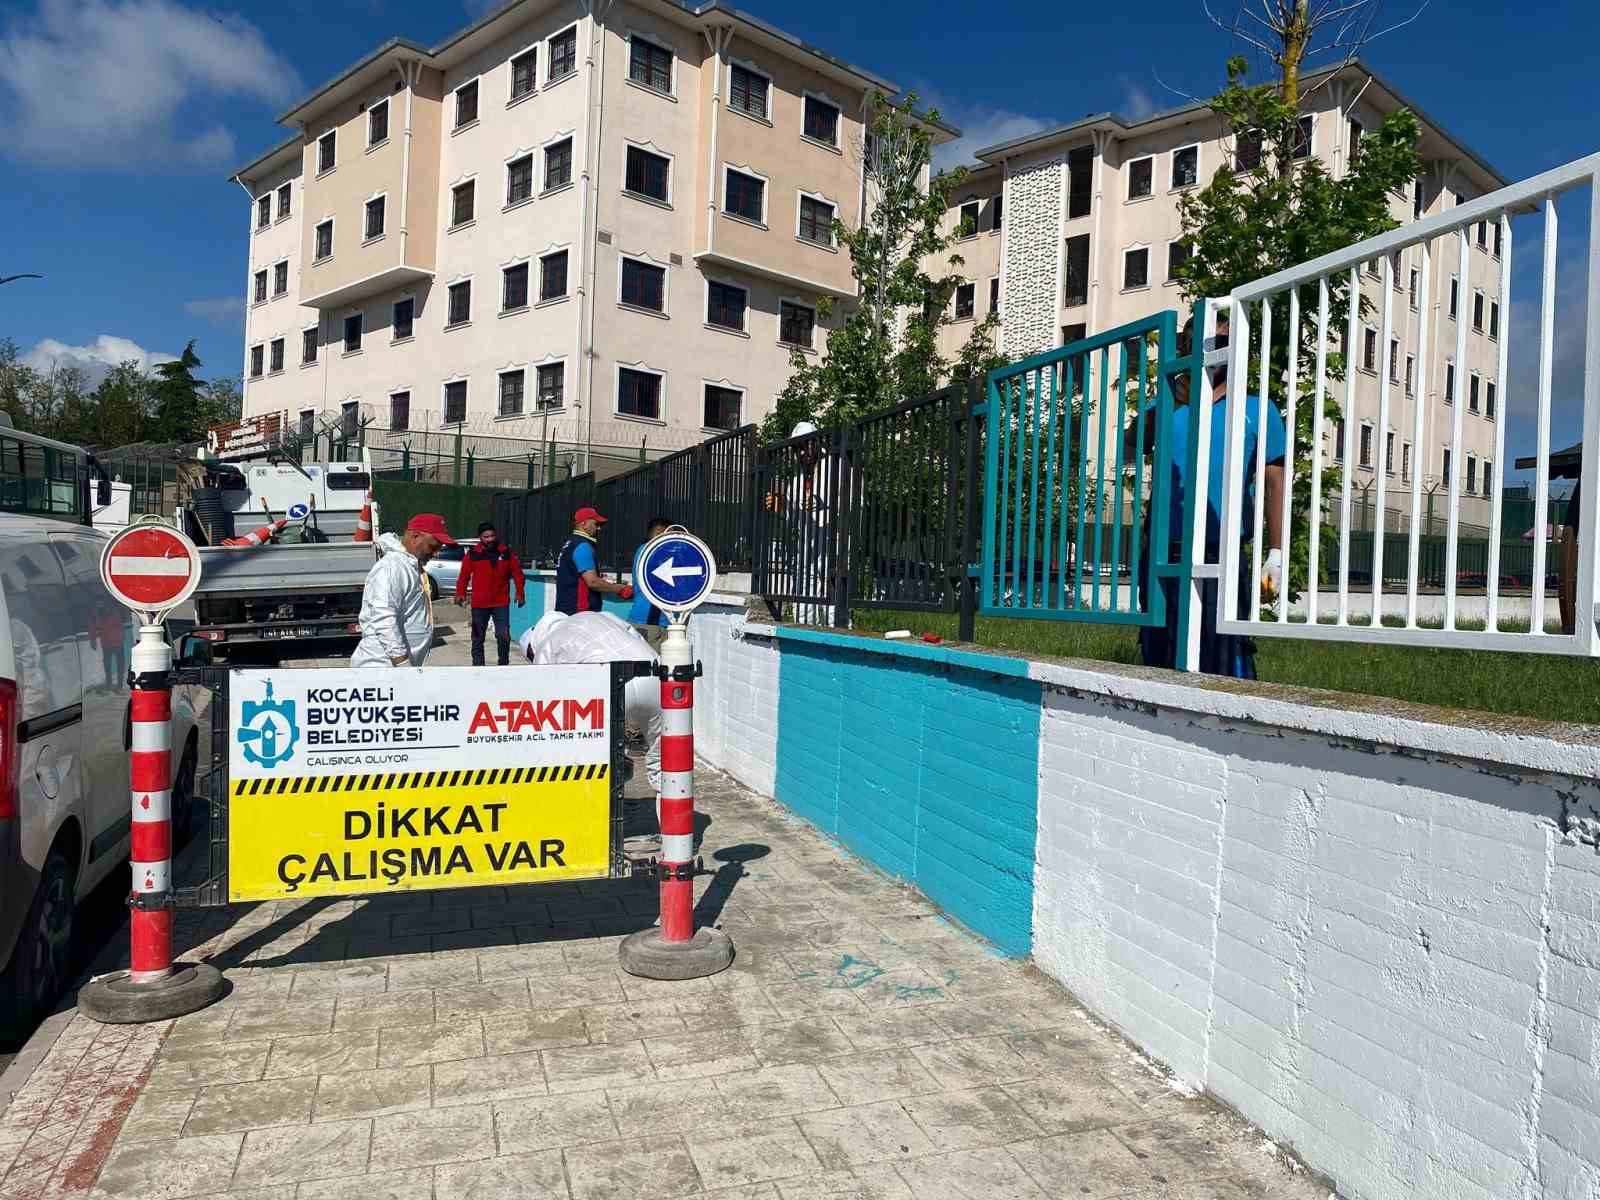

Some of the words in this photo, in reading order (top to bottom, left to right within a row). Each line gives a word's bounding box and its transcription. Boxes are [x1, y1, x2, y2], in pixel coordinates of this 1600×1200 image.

[468, 698, 605, 734] A-TAKIMI
[365, 754, 409, 764] OLUYOR
[344, 802, 507, 840] DİKKAT
[278, 845, 473, 892] ÇALIŞMA
[484, 838, 567, 871] VAR
